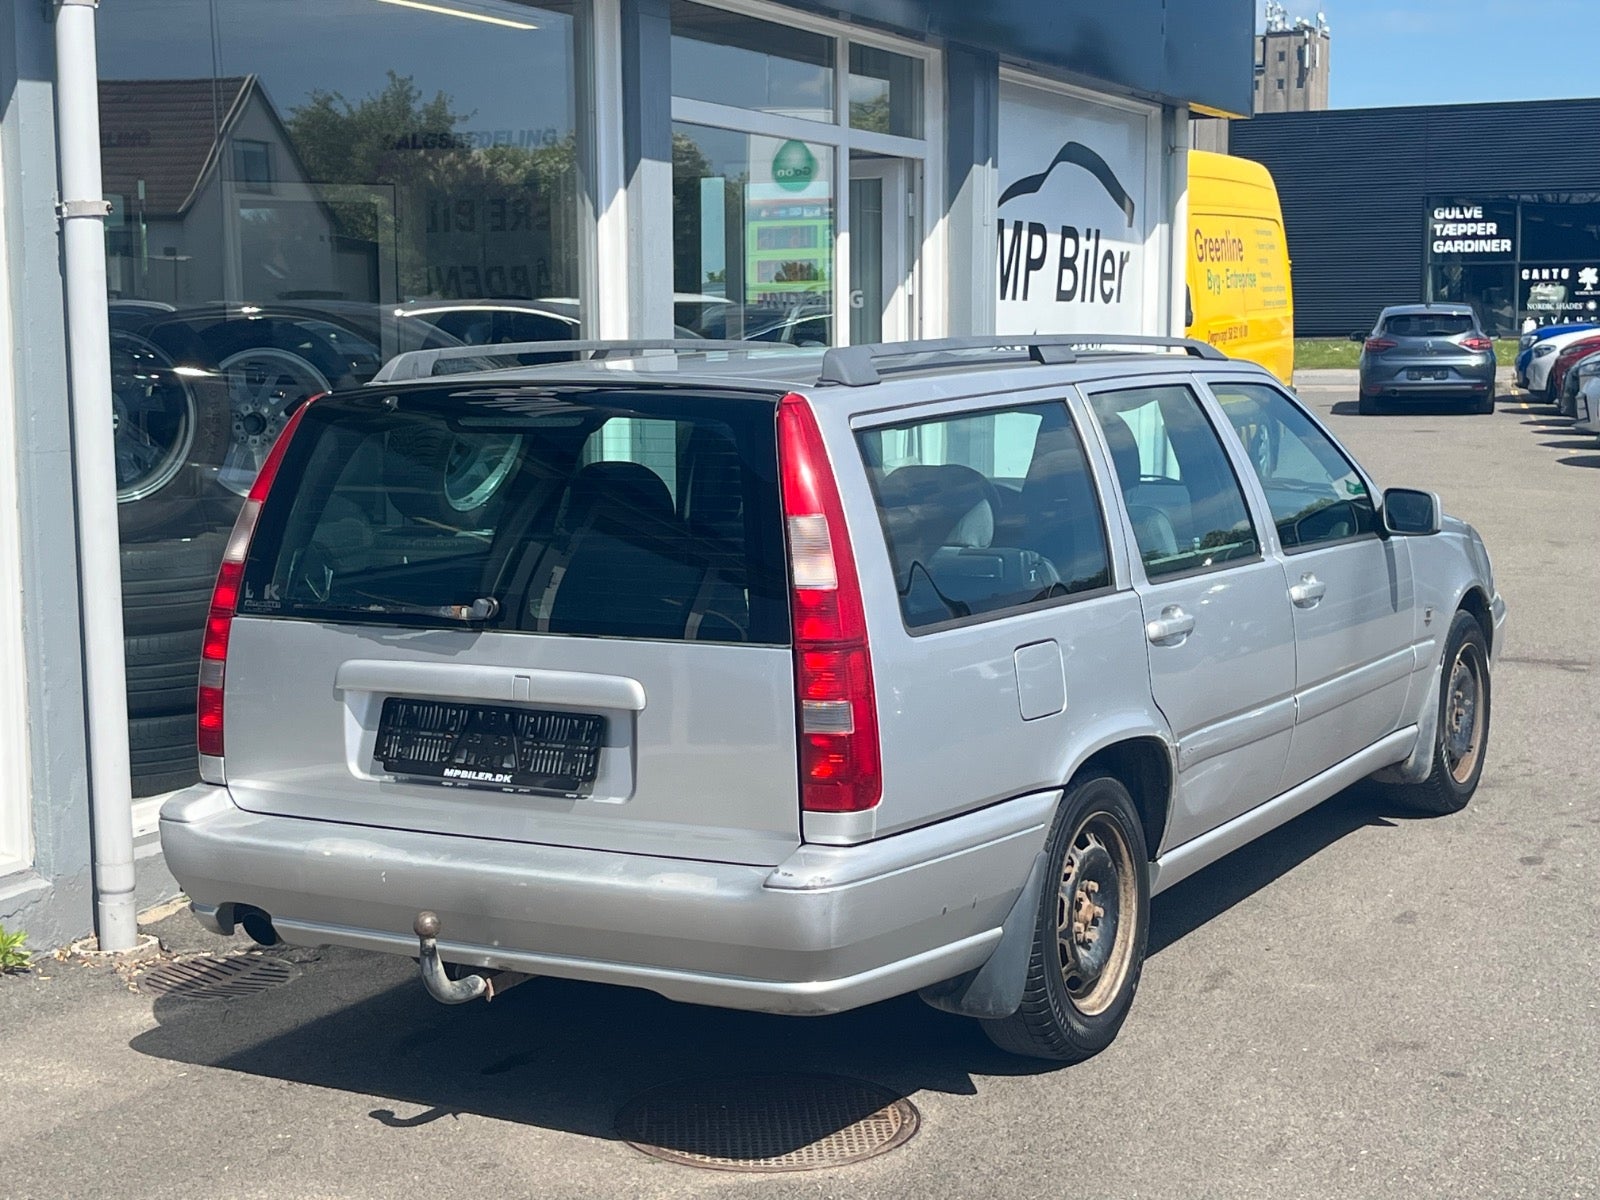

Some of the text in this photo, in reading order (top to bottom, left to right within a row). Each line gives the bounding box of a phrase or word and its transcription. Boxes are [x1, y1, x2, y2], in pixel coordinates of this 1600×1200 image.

[1433, 206, 1483, 220] GULVE
[1433, 222, 1498, 237] TÆPPER
[1194, 229, 1244, 263] Greenline
[1433, 239, 1512, 253] GARDINER
[997, 218, 1130, 304] MP Biler
[443, 768, 513, 784] MPBILER.DK
